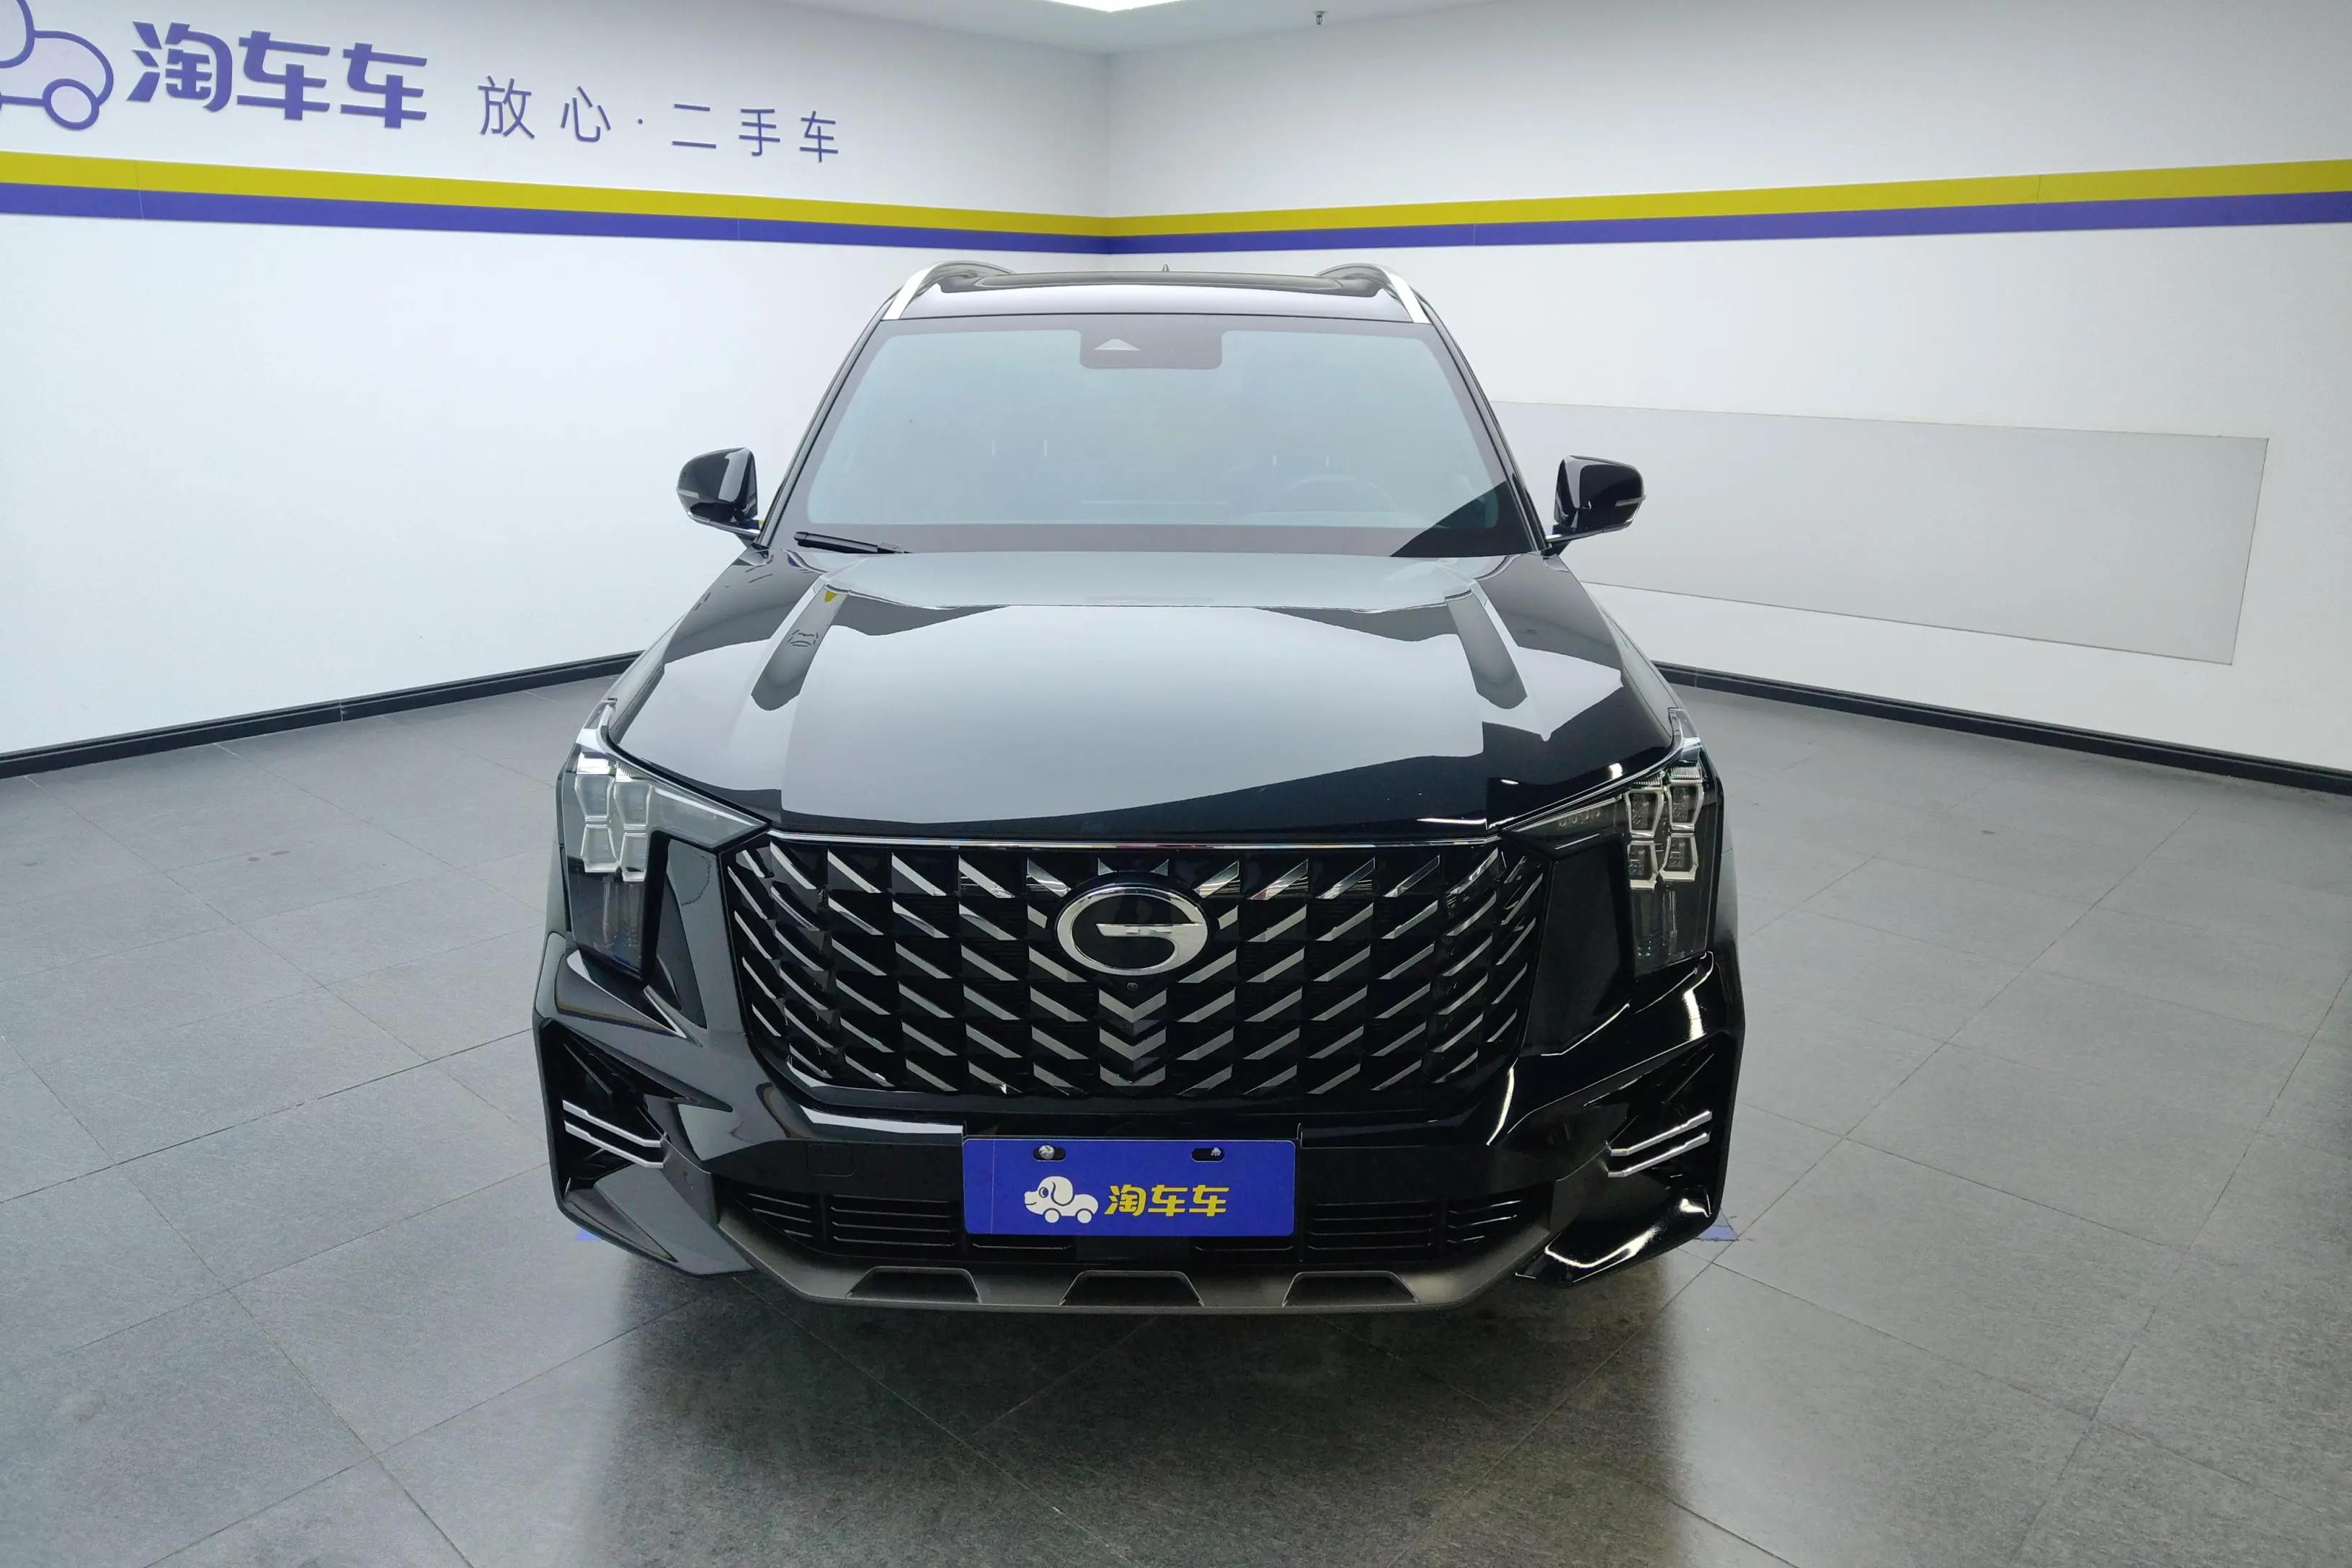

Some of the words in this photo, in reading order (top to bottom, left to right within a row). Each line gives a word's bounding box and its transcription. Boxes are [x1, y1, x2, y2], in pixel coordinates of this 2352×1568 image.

[128, 21, 427, 128] 淘车车
[1104, 1184, 1229, 1217] 淘车车
